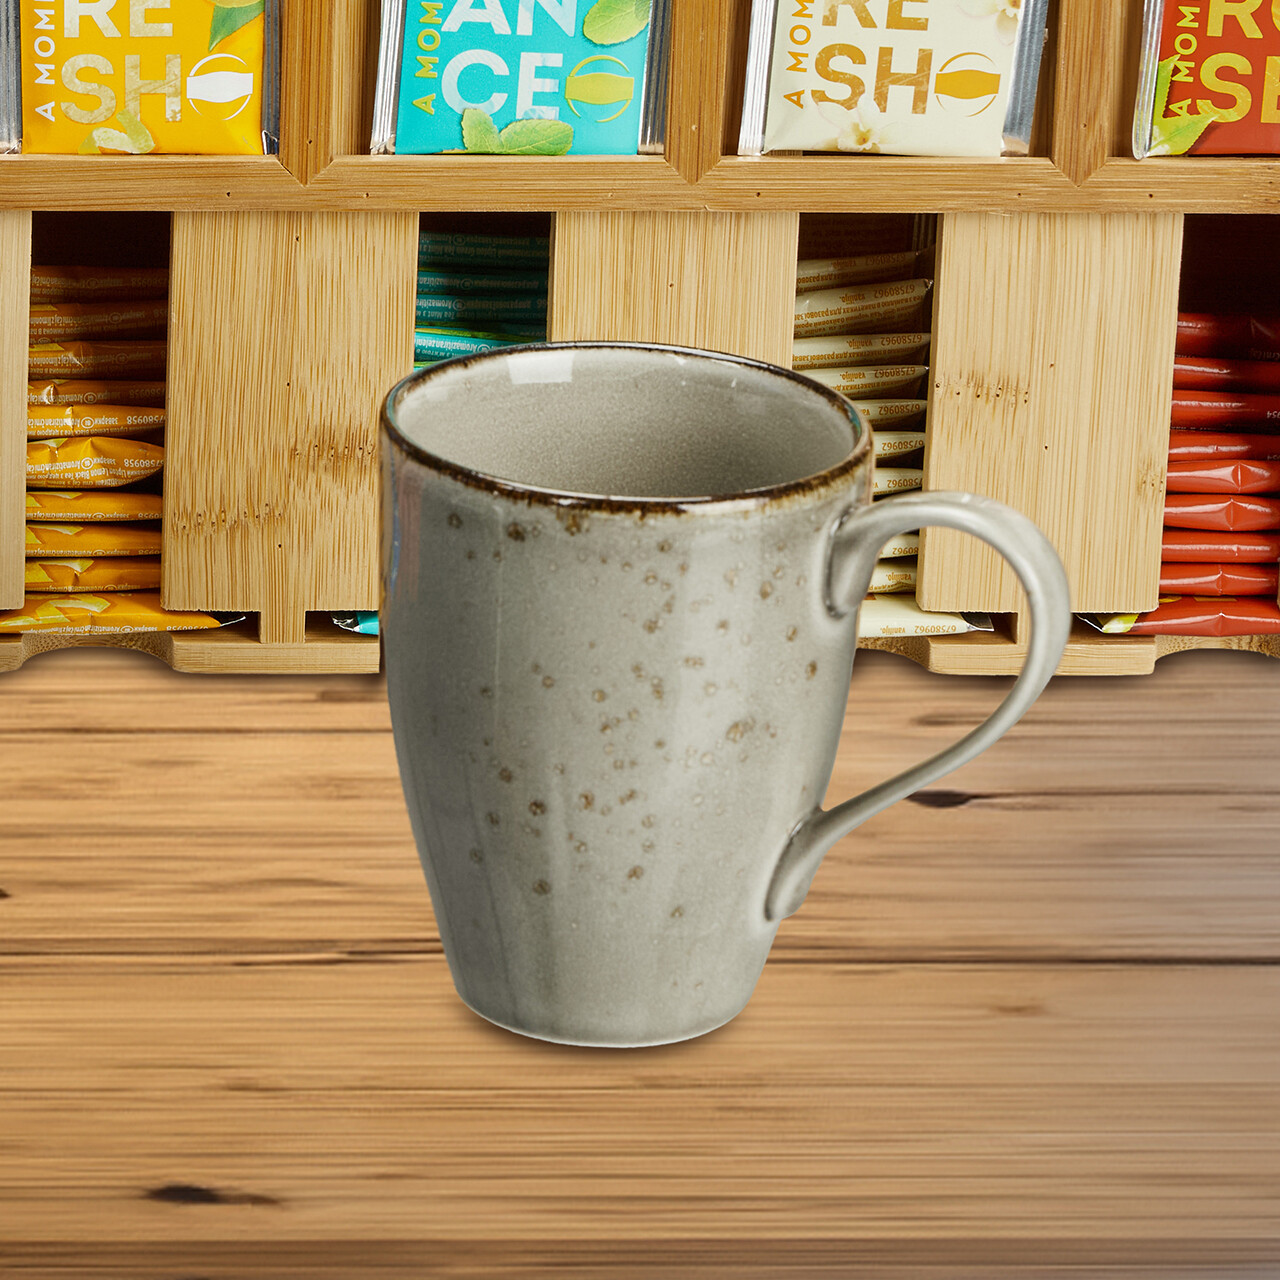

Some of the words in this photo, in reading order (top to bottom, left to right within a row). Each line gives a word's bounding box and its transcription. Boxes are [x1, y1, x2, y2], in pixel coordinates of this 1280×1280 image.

[441, 49, 564, 121] CE
[811, 43, 933, 115] SH
[61, 54, 182, 125] SH
[412, 92, 435, 115] A
[783, 88, 805, 109] A
[35, 100, 55, 122] A
[1169, 98, 1192, 118] A
[874, 284, 915, 298] 67580962
[880, 334, 922, 346] 67580962
[874, 367, 916, 379] 67580962
[878, 404, 920, 416] 67580962
[127, 415, 165, 425] 7580958
[882, 440, 924, 451] 67580962
[914, 624, 957, 634] 67580962
